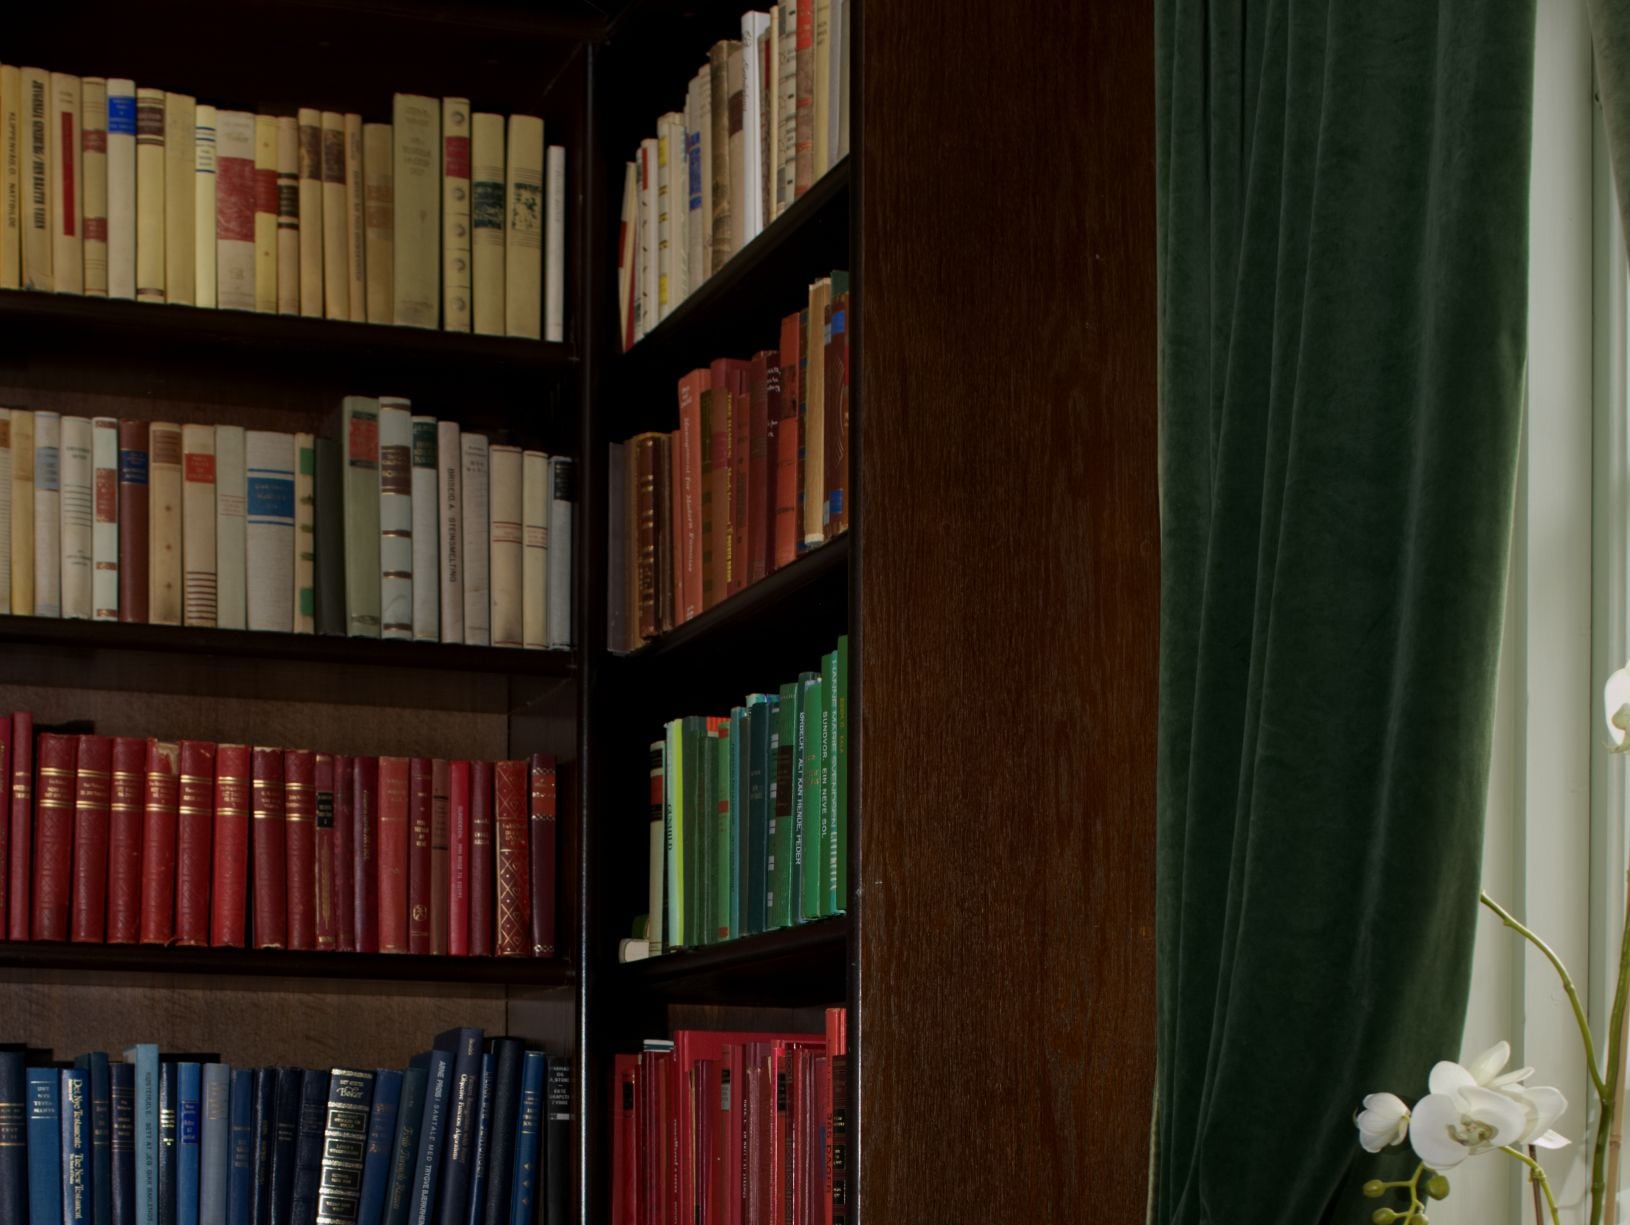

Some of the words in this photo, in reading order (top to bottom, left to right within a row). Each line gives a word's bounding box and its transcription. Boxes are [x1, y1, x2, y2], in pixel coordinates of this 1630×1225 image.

[437, 1060, 447, 1077] ARNE
[459, 1073, 468, 1101] Objective
[428, 1103, 440, 1141] SAMTALE
[456, 1102, 465, 1127] Function
[74, 1109, 83, 1149] Testamente
[75, 1153, 83, 1168] The
[421, 1164, 432, 1189] TRYGVE
[75, 1184, 84, 1219] Testament
